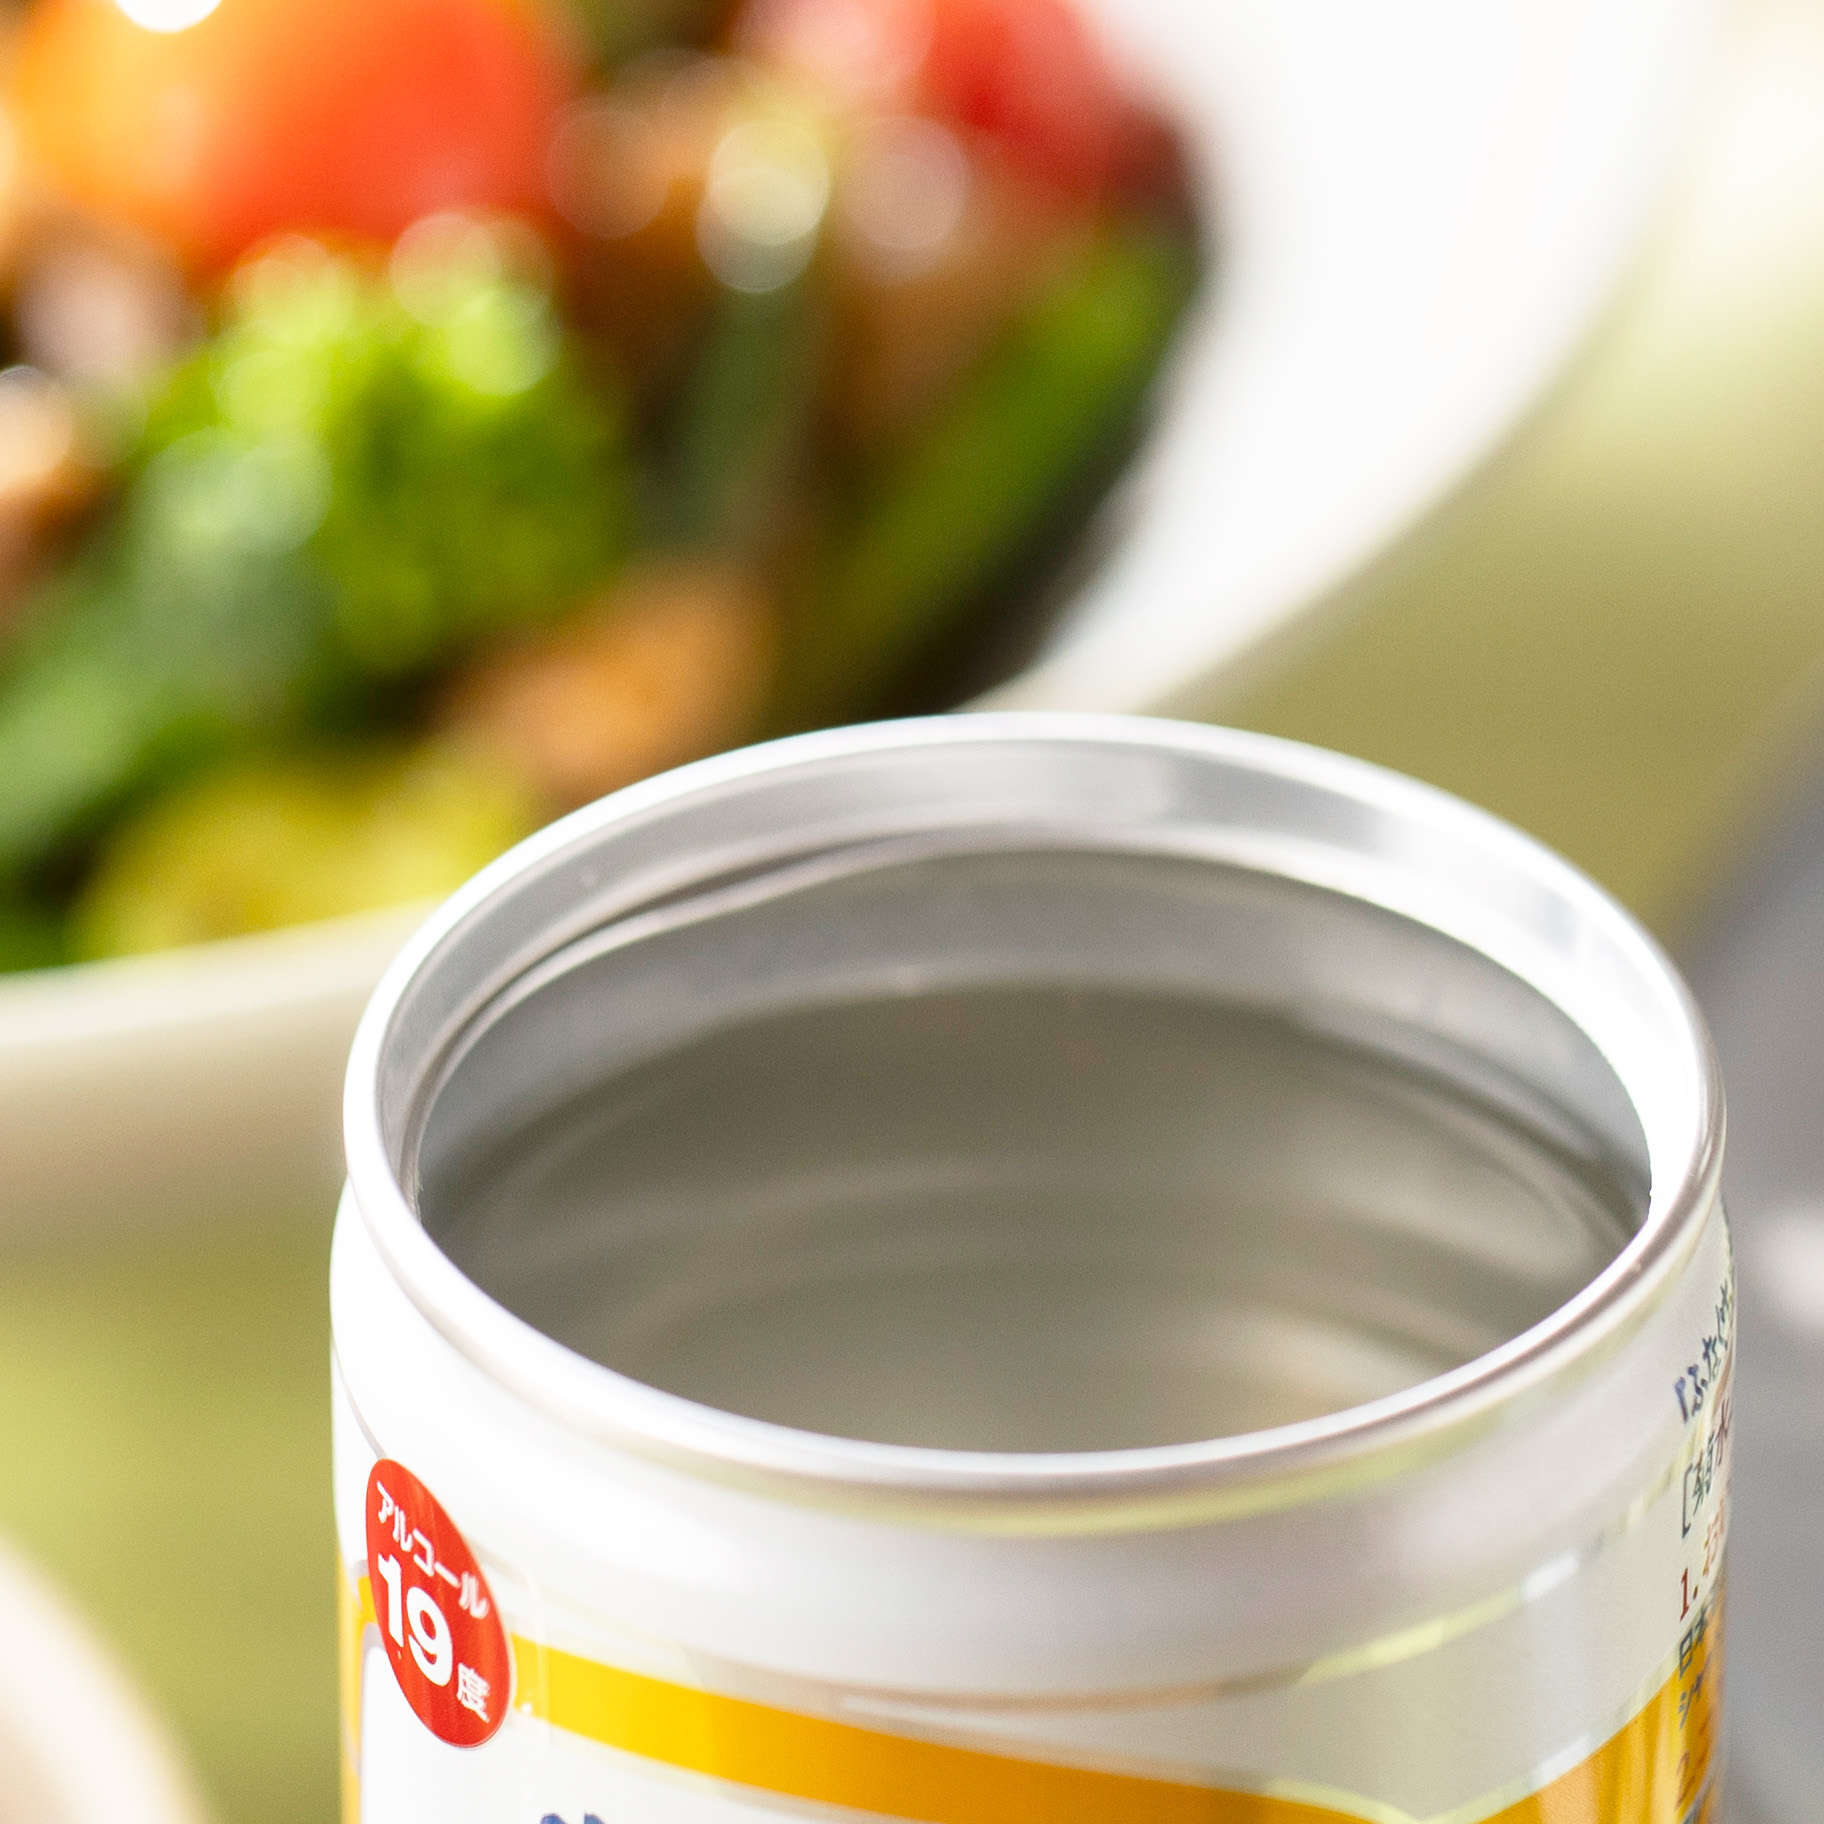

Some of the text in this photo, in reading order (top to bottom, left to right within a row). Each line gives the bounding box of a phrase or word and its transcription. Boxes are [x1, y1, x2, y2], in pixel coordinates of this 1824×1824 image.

[376, 1479, 489, 1620] アルコール
[377, 1552, 491, 1724] 19度
